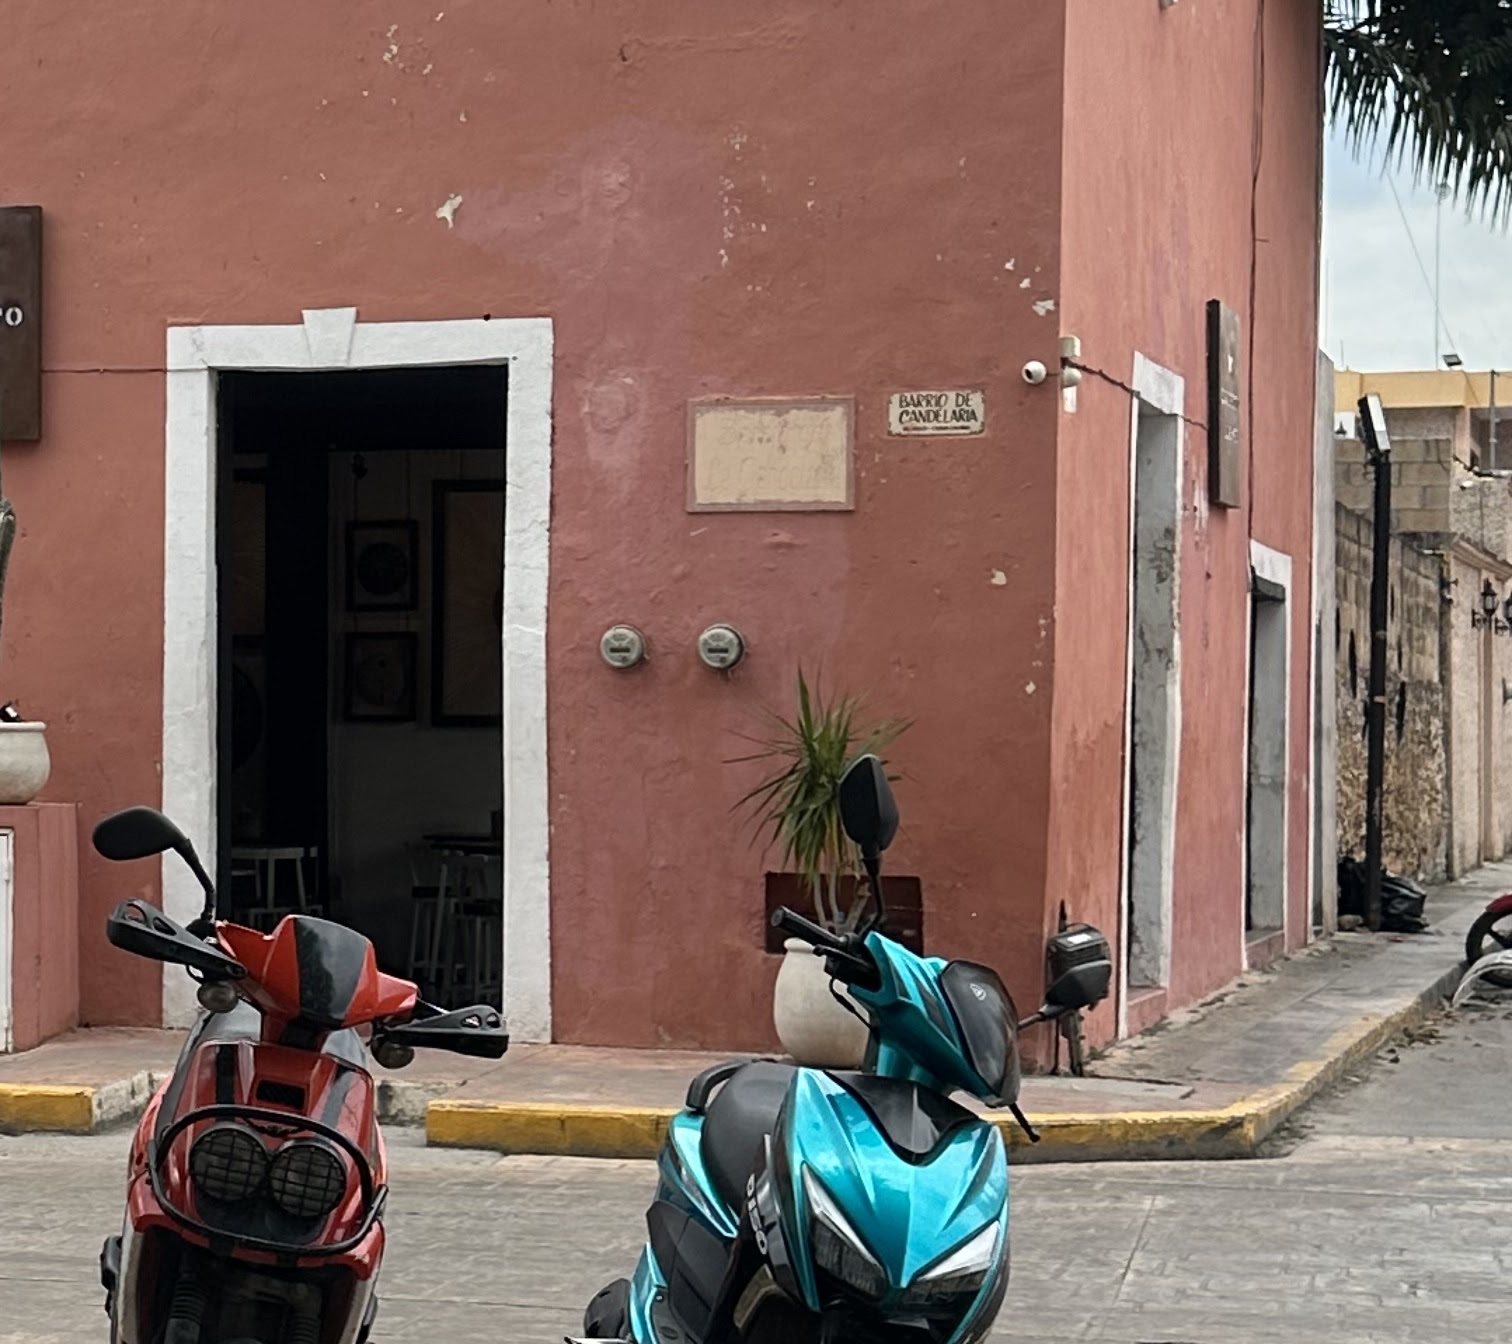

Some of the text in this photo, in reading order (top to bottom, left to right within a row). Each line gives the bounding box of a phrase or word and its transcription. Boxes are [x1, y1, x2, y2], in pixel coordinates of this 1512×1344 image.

[899, 392, 972, 408] BARRIO DE
[898, 408, 978, 424] CANDELARIA
